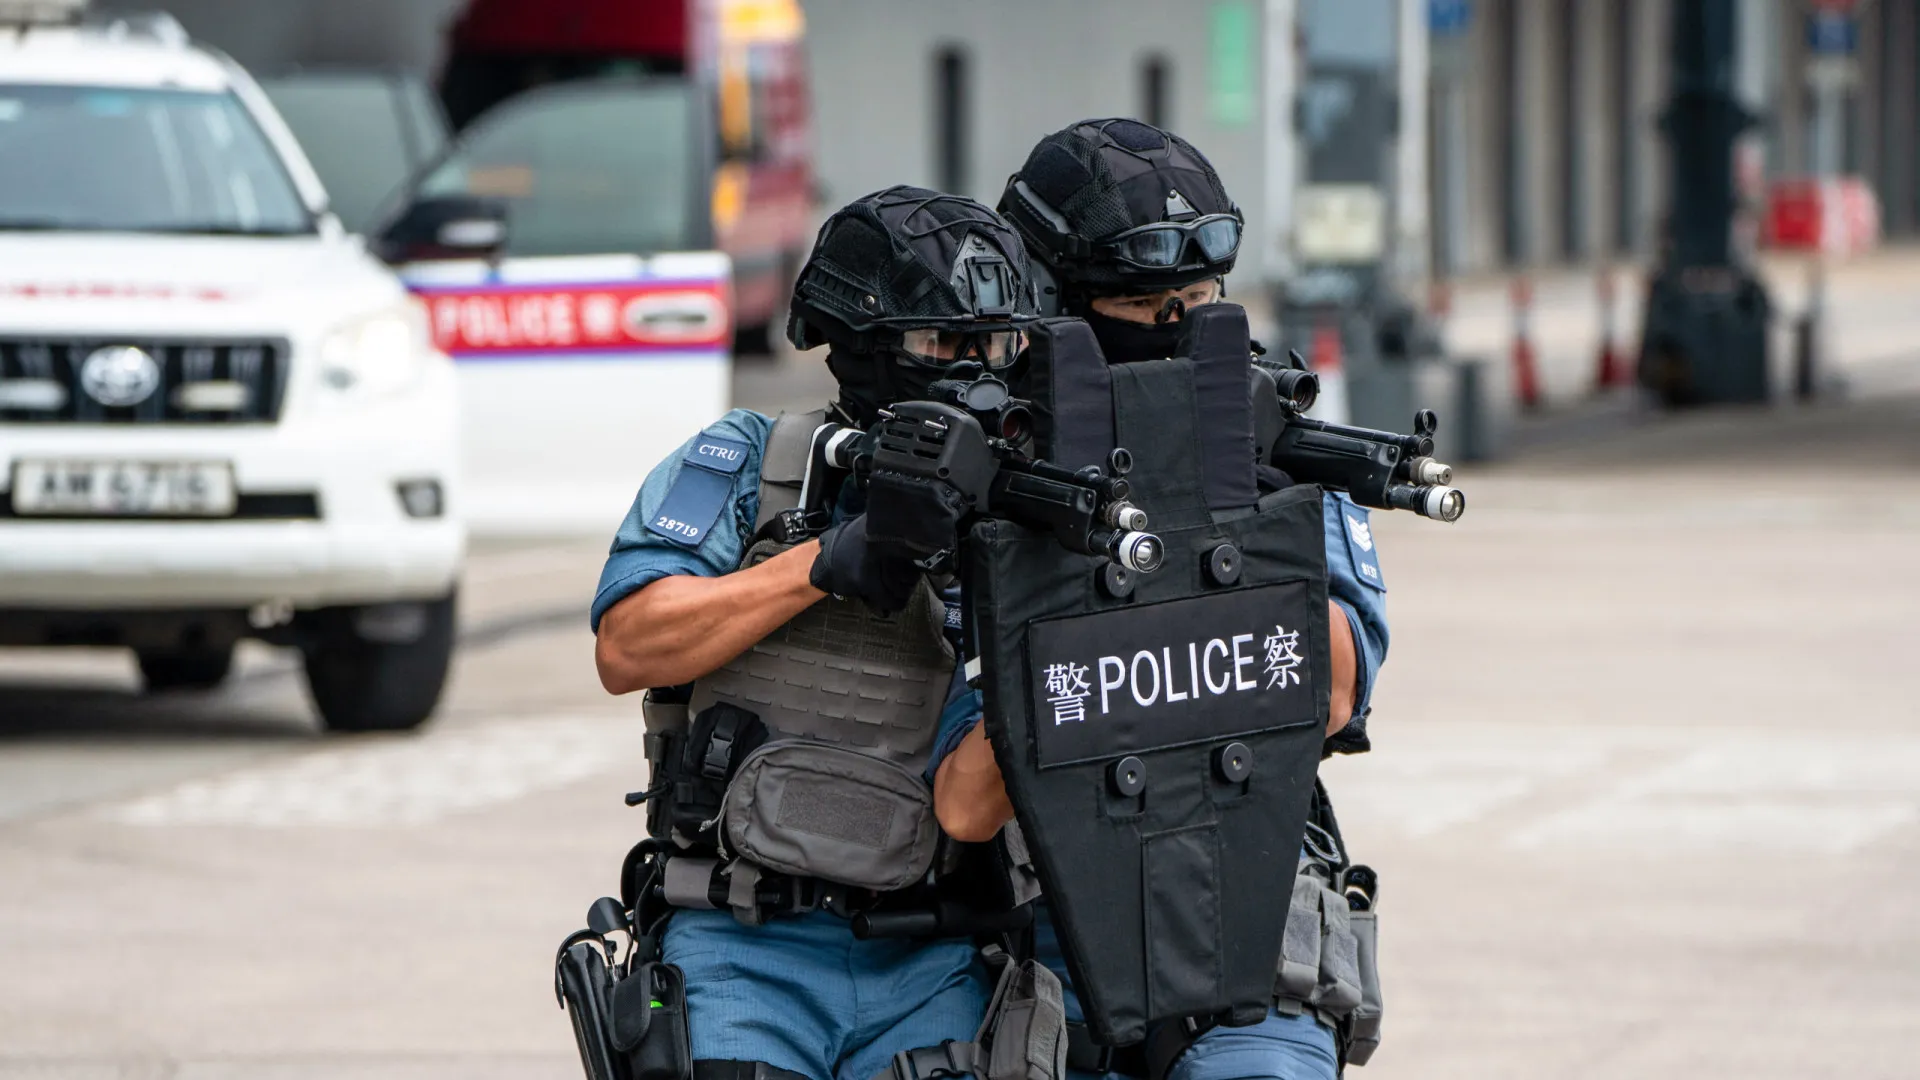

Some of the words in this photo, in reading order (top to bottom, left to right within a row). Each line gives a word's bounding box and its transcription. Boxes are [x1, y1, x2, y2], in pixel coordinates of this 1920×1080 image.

[433, 294, 575, 346] POLICE
[698, 444, 739, 461] CTRU
[656, 516, 698, 537] 28719
[1043, 661, 1092, 726] 警
[1098, 633, 1257, 714] POLICE
[1263, 624, 1304, 690] 察
